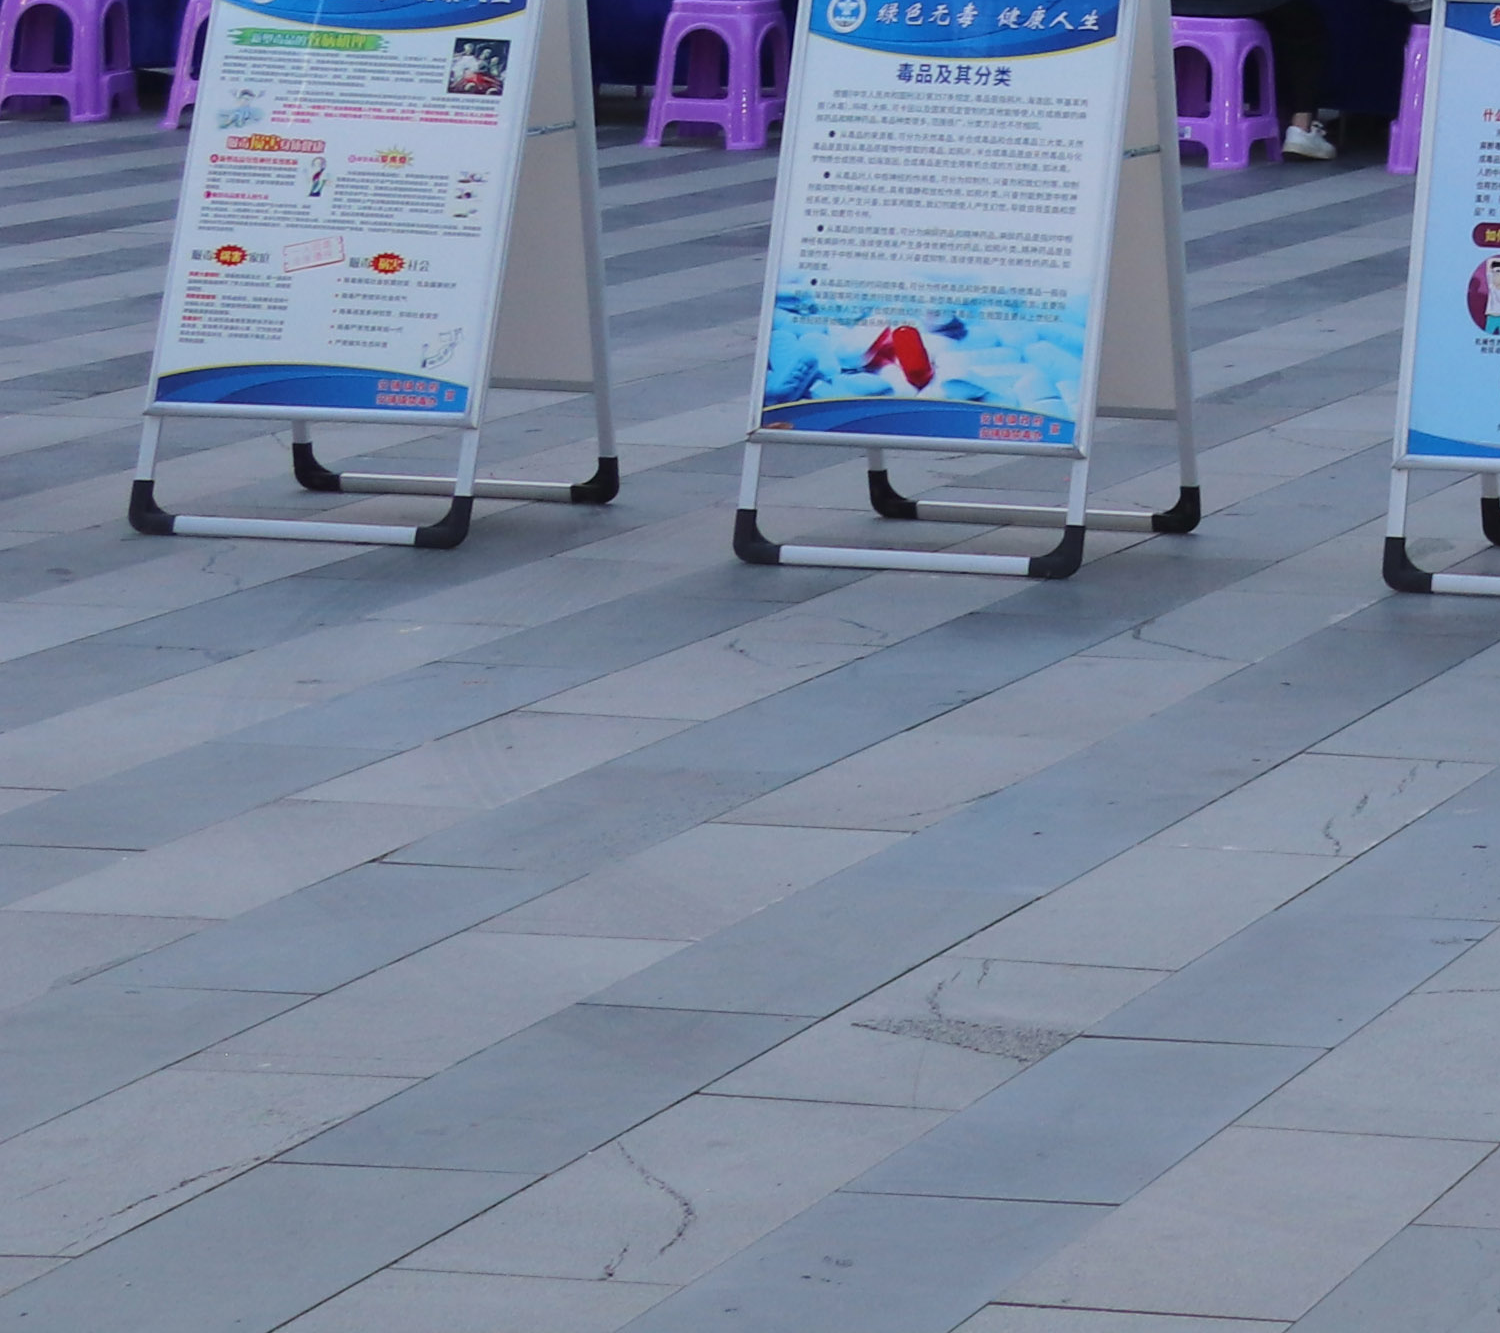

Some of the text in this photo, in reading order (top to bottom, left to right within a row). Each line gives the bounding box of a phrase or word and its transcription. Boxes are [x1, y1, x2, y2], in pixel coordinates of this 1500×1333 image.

[876, 2, 1100, 32] 绿色无毒 健康人生
[896, 62, 1013, 87] 毒品及其分类
